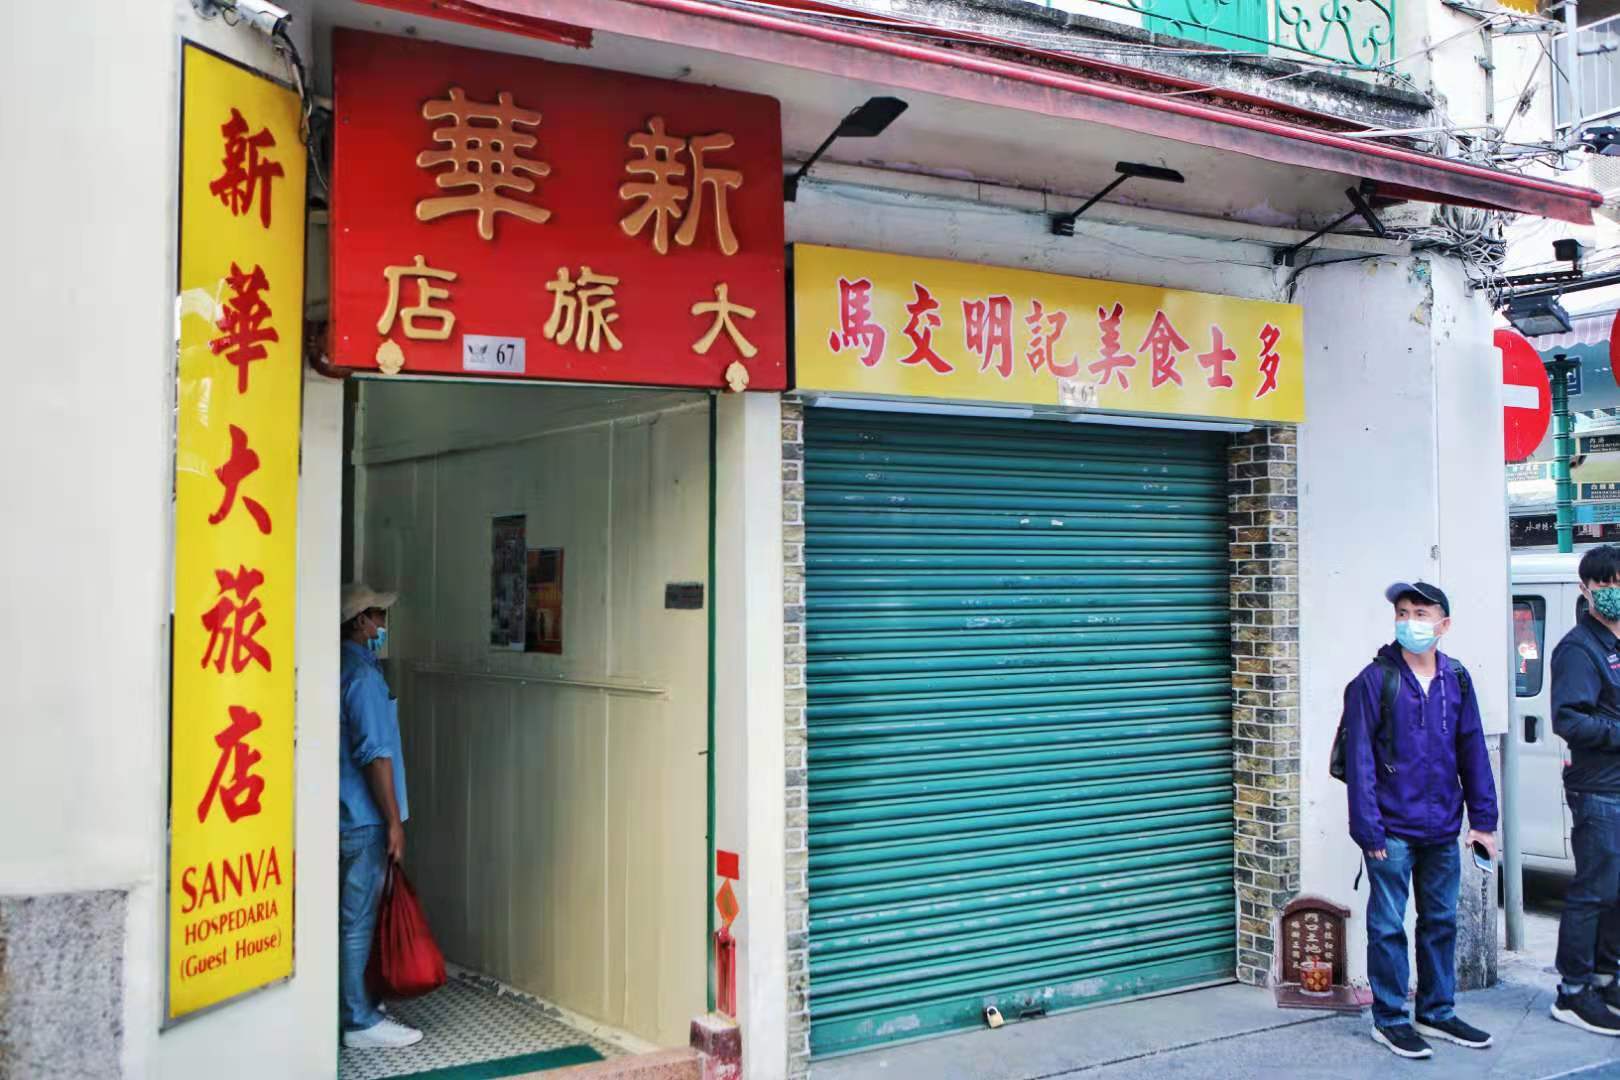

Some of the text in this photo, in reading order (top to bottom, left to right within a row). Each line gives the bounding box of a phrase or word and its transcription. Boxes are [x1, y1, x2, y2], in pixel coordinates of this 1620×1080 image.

[496, 343, 515, 365] 67
[828, 277, 1282, 399] 馬交明記美食士多
[198, 107, 285, 823] 新華大旅店
[181, 846, 281, 914] SANVA
[184, 899, 279, 946] HOSPEDARIA
[180, 928, 282, 982] (Guest House)
